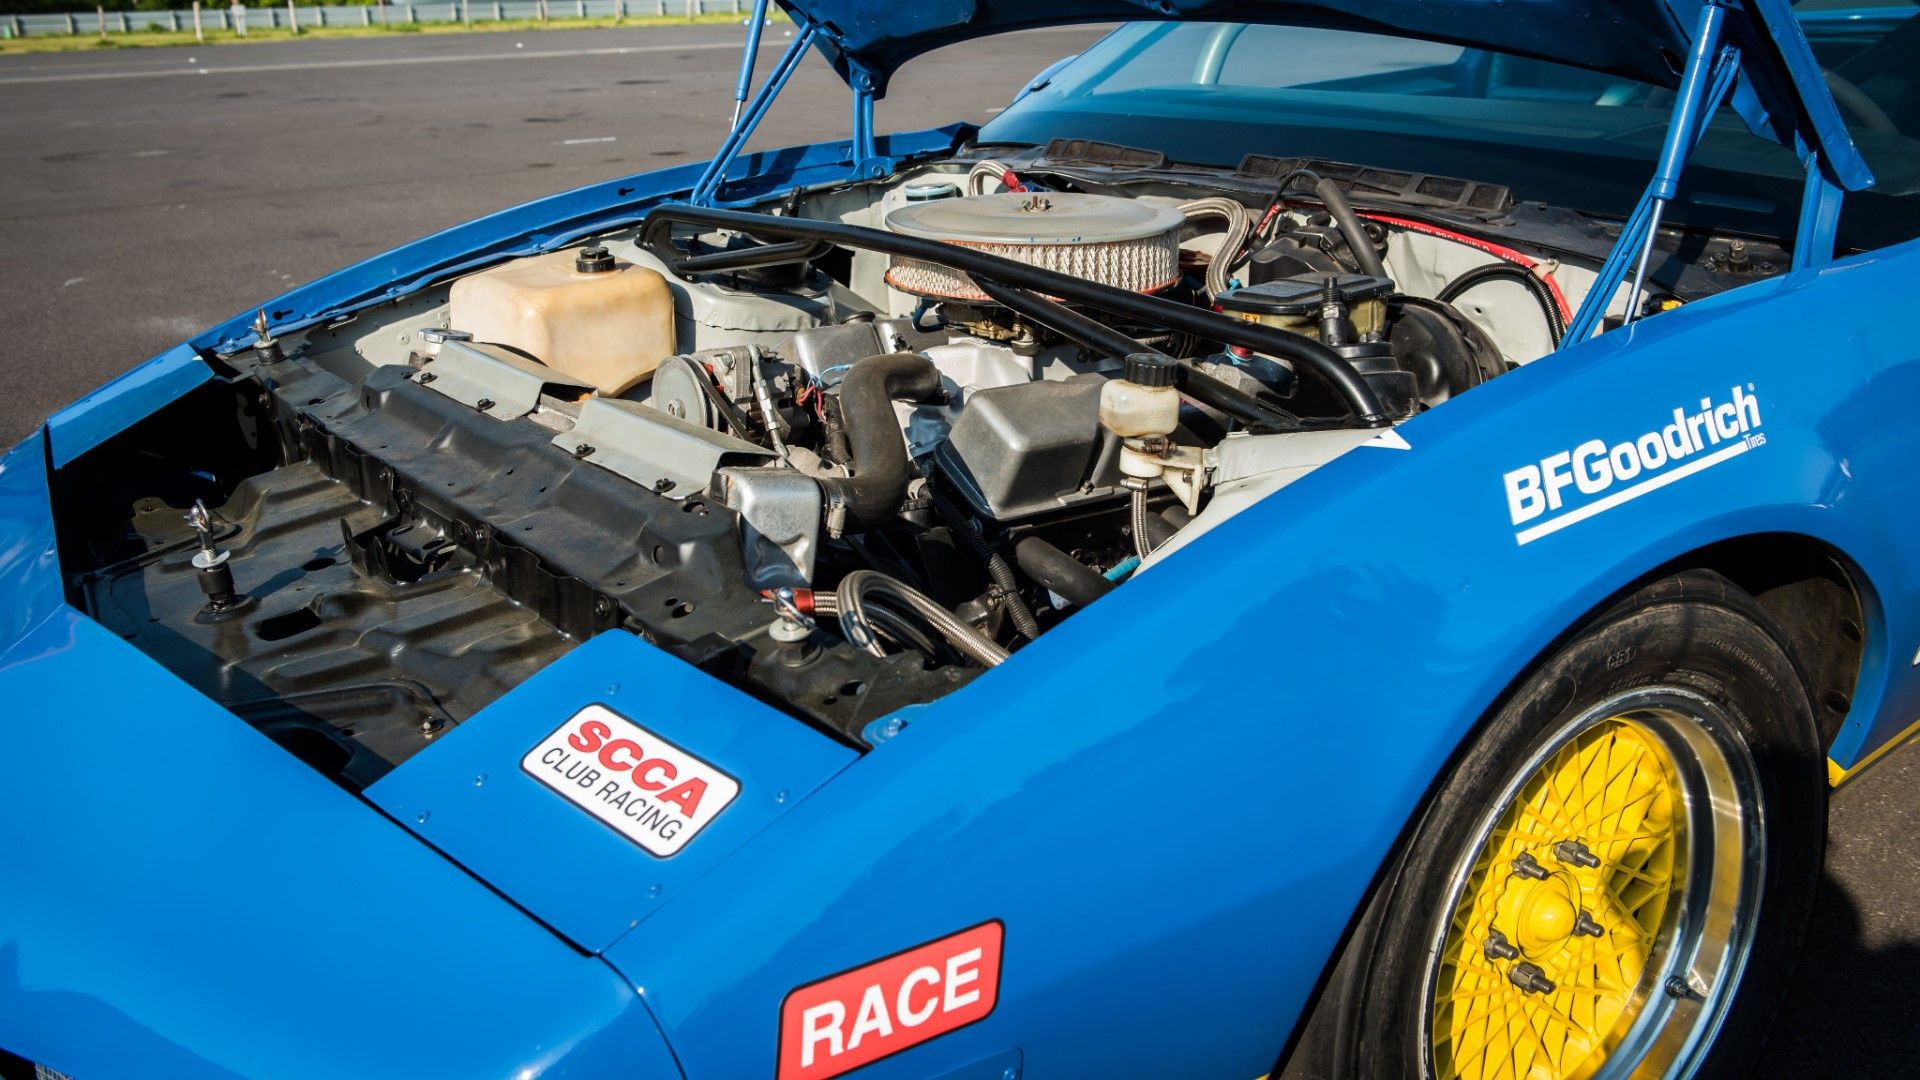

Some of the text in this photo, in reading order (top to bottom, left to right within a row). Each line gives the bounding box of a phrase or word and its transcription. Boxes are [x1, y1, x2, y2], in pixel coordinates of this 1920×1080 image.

[1742, 432, 1766, 450] Tires
[541, 747, 682, 841] CLUB RACING
[568, 720, 708, 819] SCCA
[801, 947, 982, 1068] RACE
